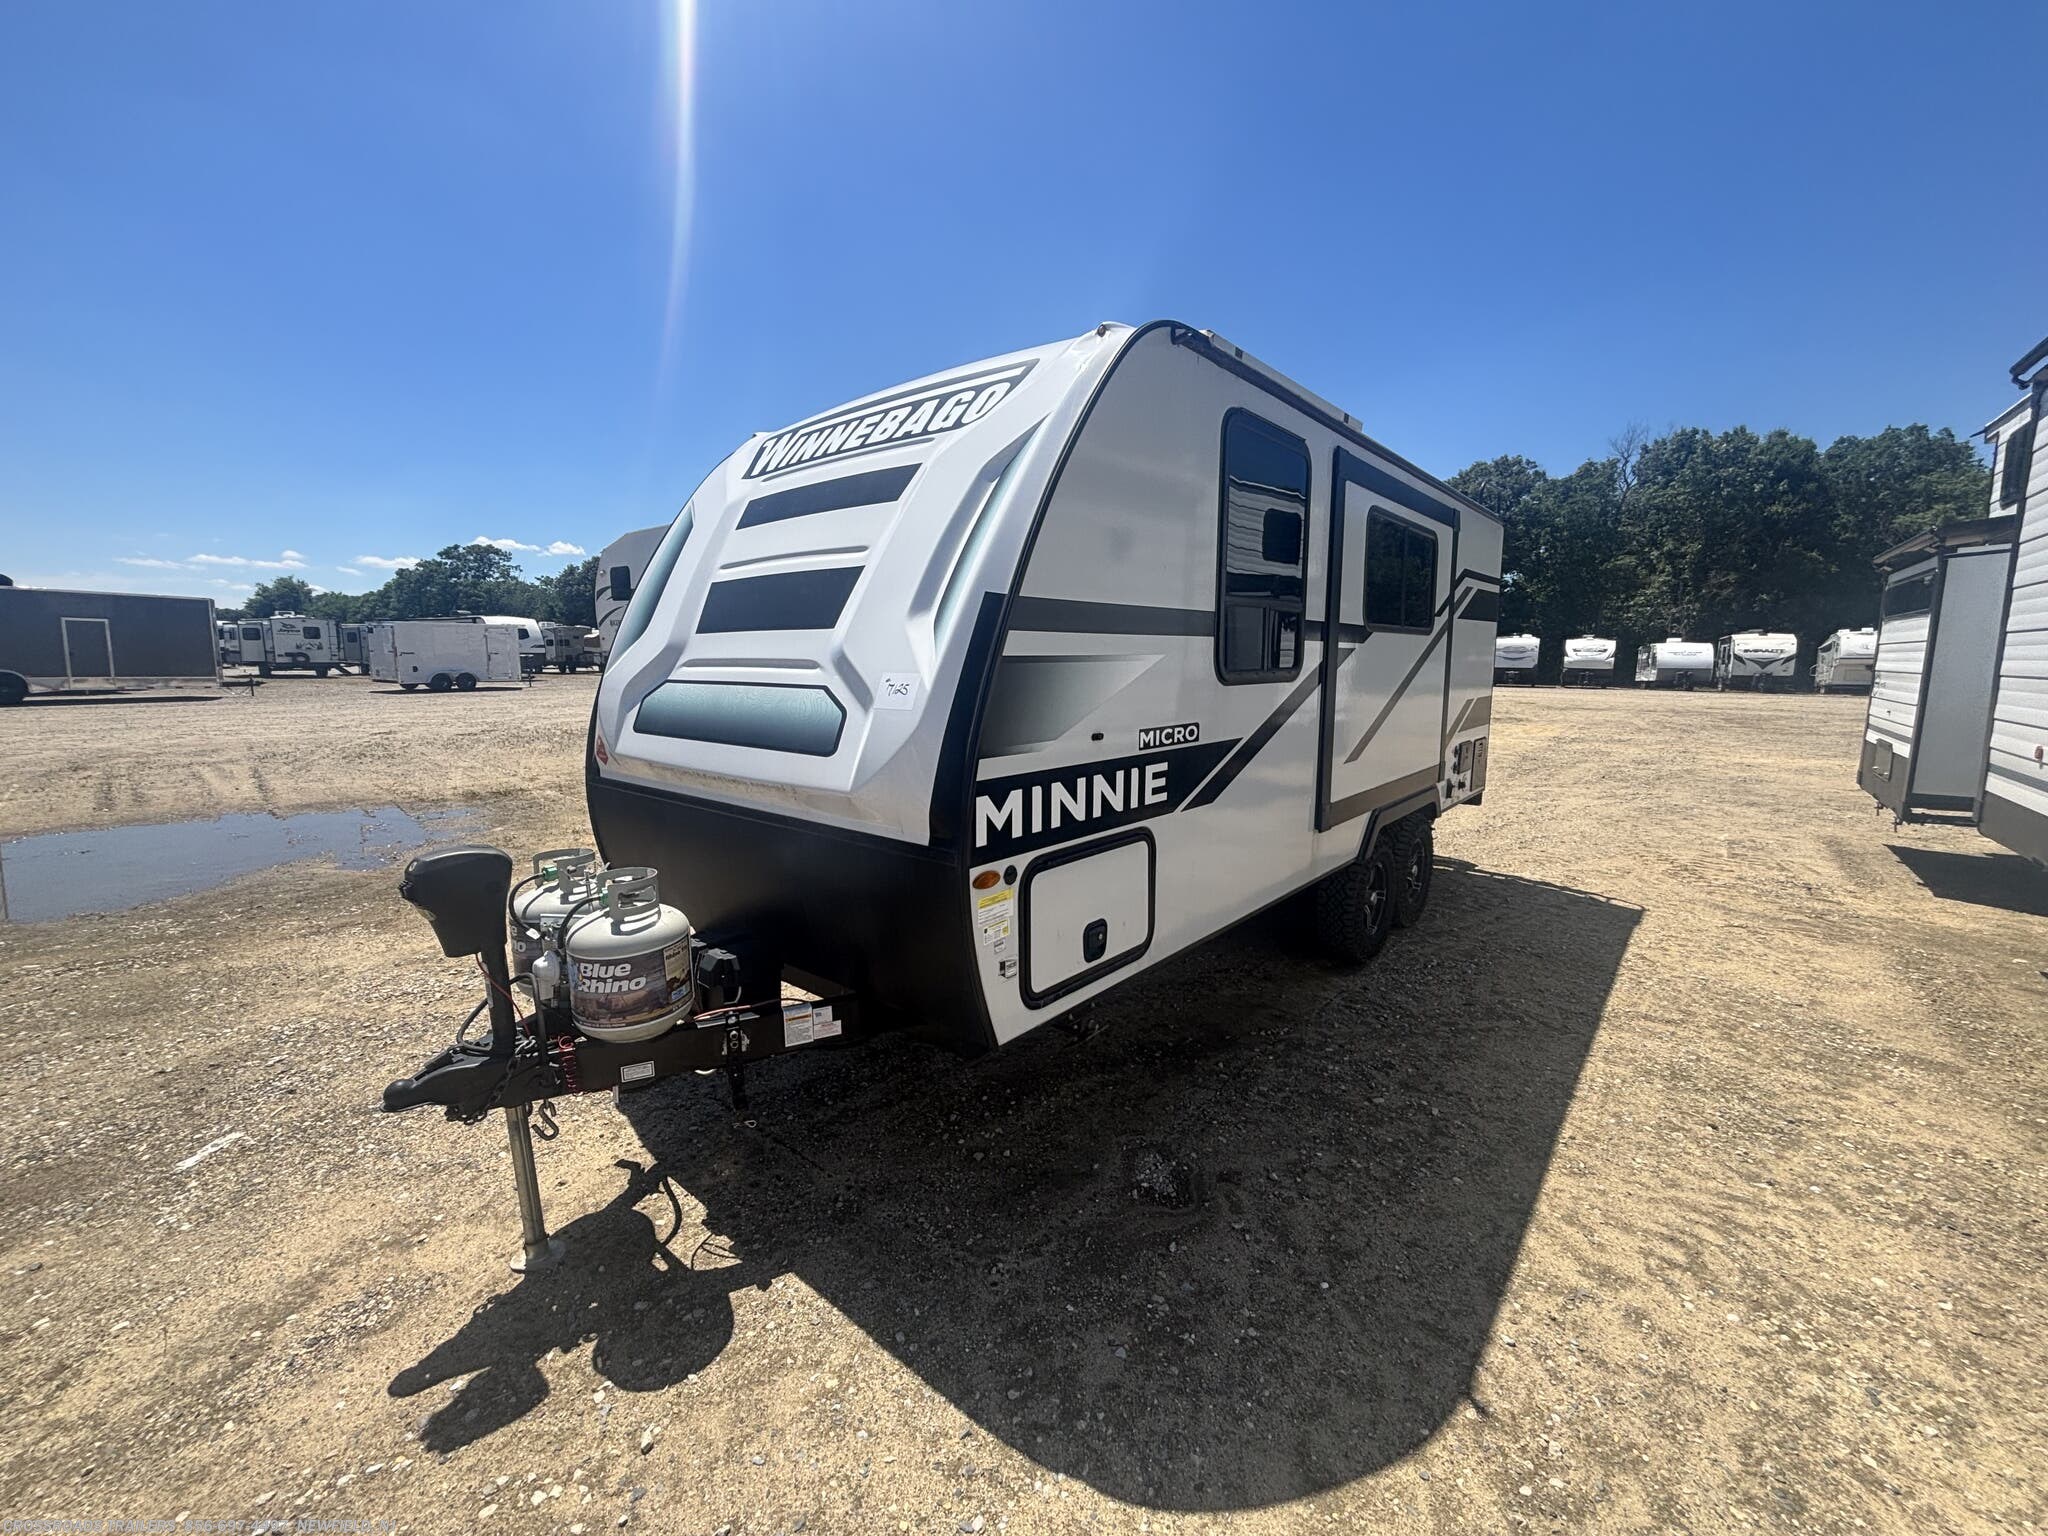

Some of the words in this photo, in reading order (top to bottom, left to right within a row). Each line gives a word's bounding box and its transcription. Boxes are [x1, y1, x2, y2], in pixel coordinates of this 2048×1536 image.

[750, 381, 1012, 477] WINNEBAGO
[1139, 725, 1198, 749] MICRO
[975, 761, 1169, 849] MINNIE
[580, 962, 632, 978] Blue
[578, 976, 647, 994] Rhino
